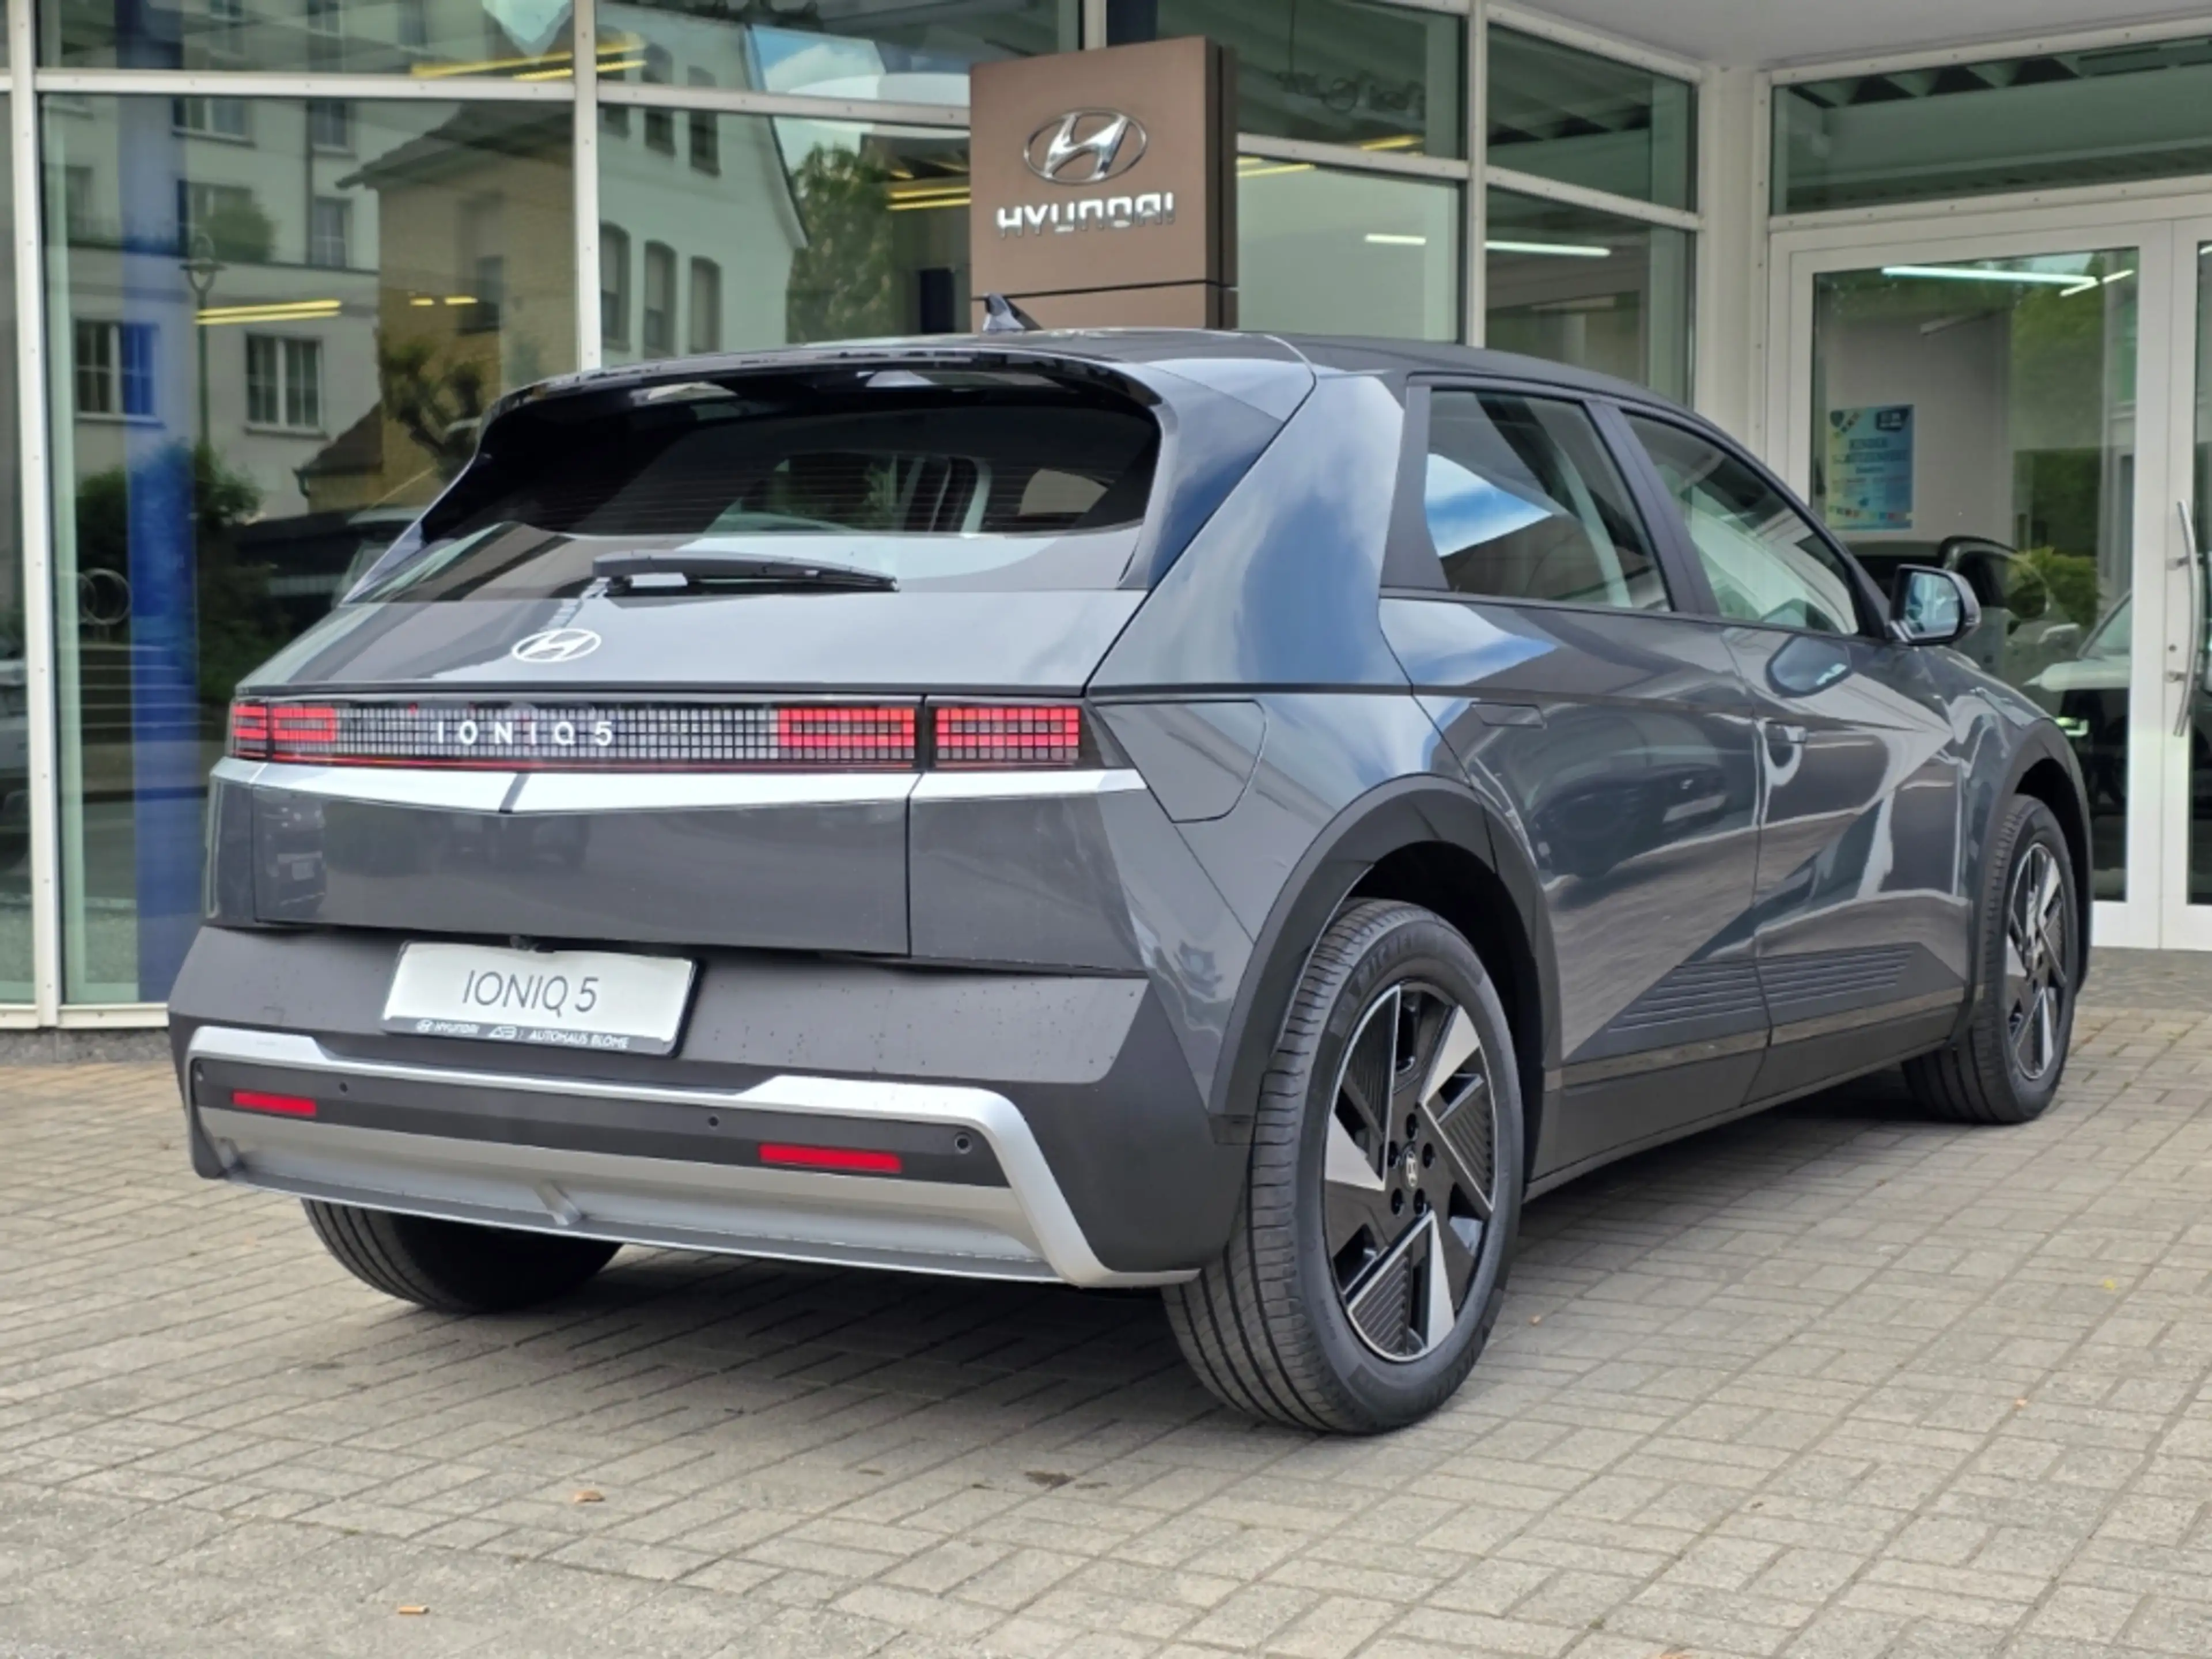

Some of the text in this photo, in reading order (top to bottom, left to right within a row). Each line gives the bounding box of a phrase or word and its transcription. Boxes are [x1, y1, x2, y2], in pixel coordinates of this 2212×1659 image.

[997, 191, 1175, 238] HYUNDAI
[438, 720, 575, 746] IONIQ
[462, 969, 599, 1018] IONIQ 5
[528, 1029, 589, 1045] AUTOHAUS
